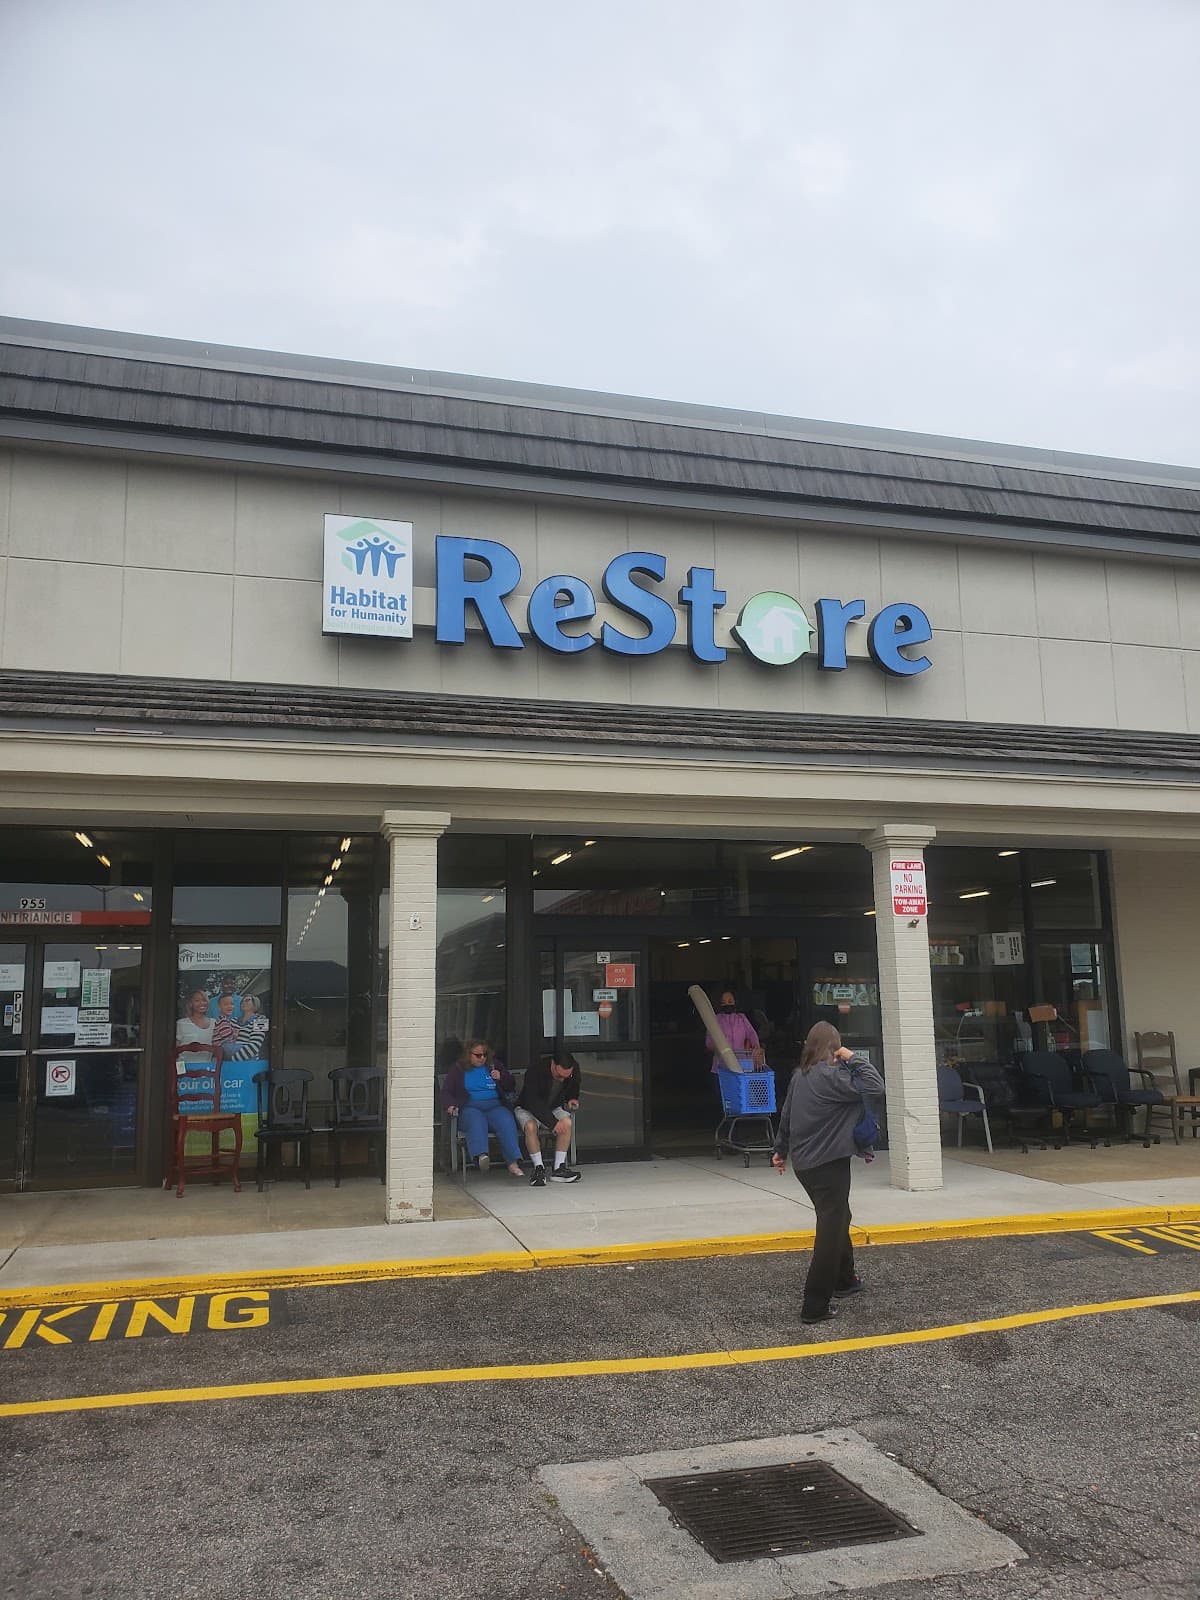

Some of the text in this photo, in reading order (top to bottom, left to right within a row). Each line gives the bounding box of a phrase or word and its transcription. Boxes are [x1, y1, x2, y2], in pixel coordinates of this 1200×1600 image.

[331, 586, 407, 611] Habitat
[435, 535, 932, 677] ReStore
[331, 606, 407, 626] for Humanity
[904, 873, 912, 882] NO
[895, 885, 923, 894] PARKING
[21, 899, 45, 909] 955
[178, 1081, 201, 1091] our
[223, 1079, 244, 1089] car
